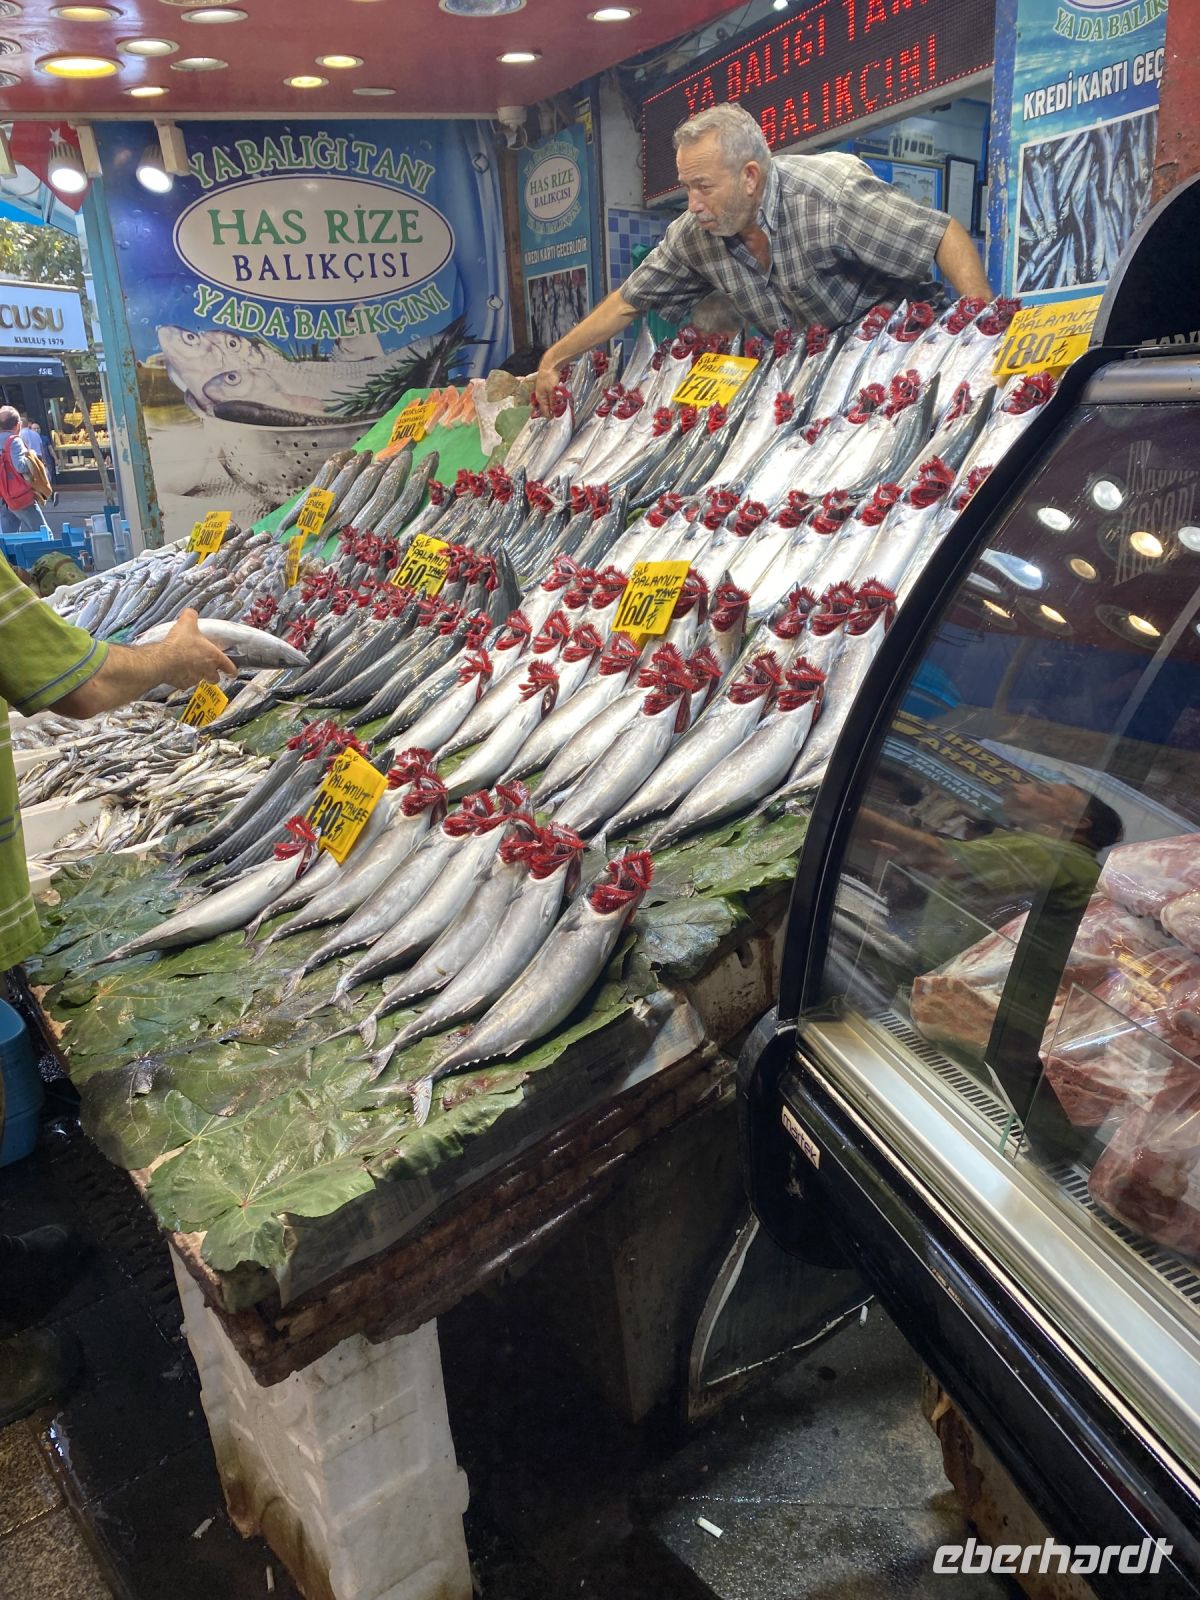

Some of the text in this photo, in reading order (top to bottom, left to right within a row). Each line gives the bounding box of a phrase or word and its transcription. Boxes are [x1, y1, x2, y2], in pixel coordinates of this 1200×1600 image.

[842, 0, 927, 41] TA
[1023, 71, 1073, 120] KREDİ
[1077, 60, 1128, 104] KARTI
[188, 132, 436, 194] YA BALIĞI TANI
[529, 168, 575, 196] HAS RİZE
[533, 187, 572, 209] BALIKÇISI
[207, 204, 424, 246] HAS RİZE
[232, 252, 411, 284] BALIKÇISI
[293, 282, 450, 340] BALIKÇINI
[48, 337, 65, 346] 1979
[632, 575, 682, 589] PALAMUT
[655, 587, 681, 599] TANE
